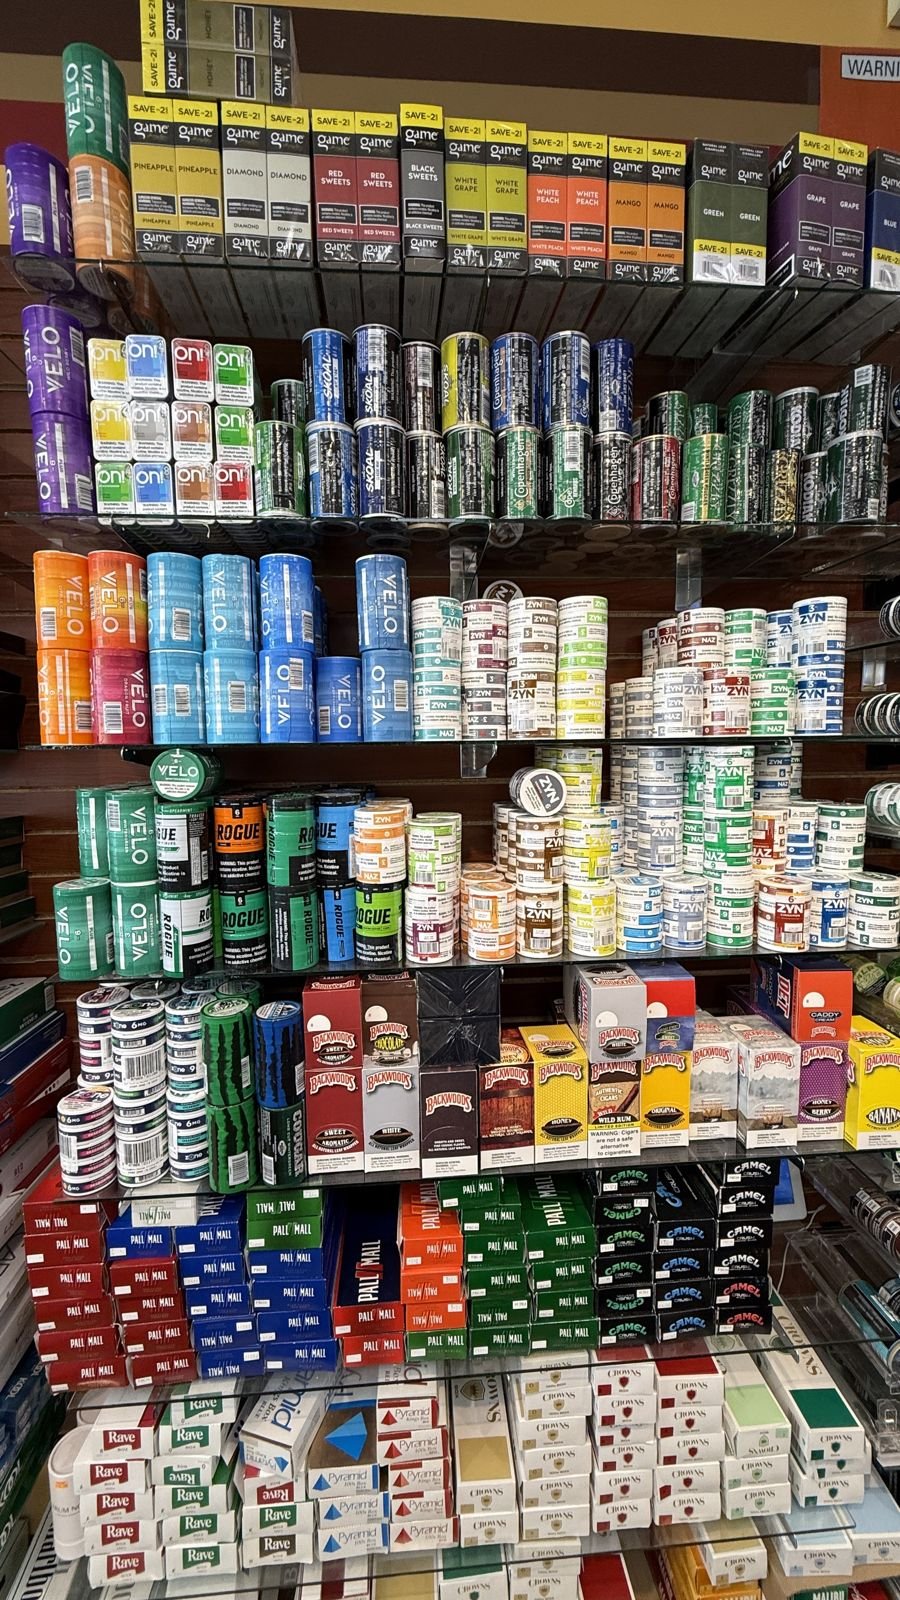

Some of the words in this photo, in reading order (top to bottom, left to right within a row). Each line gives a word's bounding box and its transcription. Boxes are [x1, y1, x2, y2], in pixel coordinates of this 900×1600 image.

[168, 51, 184, 88] game
[65, 63, 79, 136] VELO
[134, 122, 168, 138] game
[271, 131, 304, 147] game
[360, 138, 393, 153] game
[449, 142, 481, 158] game
[134, 163, 173, 172] PINEAPPLE
[411, 164, 434, 173] BLACK
[572, 156, 603, 172] game
[179, 166, 217, 175] PINEAPPLE
[227, 169, 263, 177] DIAMOND
[271, 172, 307, 180] DIAMOND
[701, 164, 727, 180] game
[837, 163, 864, 178] game
[321, 177, 351, 186] SWEETS
[409, 173, 438, 181] SWEETS
[496, 179, 518, 187] WHITE
[363, 180, 392, 188] SWEETS
[496, 187, 519, 195] GRAPE
[537, 188, 560, 196] WHITE
[537, 196, 559, 204] PEACH
[576, 198, 599, 206] PEACH
[807, 194, 826, 204] GRAPE
[840, 200, 859, 210] GRAPE
[654, 202, 679, 210] MANGO
[703, 208, 724, 216] GREEN
[739, 213, 760, 221] GREEN
[884, 219, 897, 228] BLUE
[42, 326, 61, 393] VELO
[323, 354, 332, 400] SKOAL
[494, 349, 504, 410] Copenhagen
[365, 376, 374, 413] SKOAL
[36, 434, 51, 500] VELO
[366, 449, 375, 492] SKOAL
[515, 437, 529, 498] Copenhagen
[608, 446, 623, 504] Copenhagen
[67, 576, 84, 635] VELO
[101, 571, 119, 633] VELO
[211, 571, 226, 632] VELO
[383, 574, 397, 633] VELO
[443, 618, 460, 628] ZYN
[800, 613, 825, 624] ZYN
[371, 666, 386, 726] VELO
[512, 689, 535, 700] ZYN
[727, 686, 749, 695] ZYN
[799, 689, 824, 698] ZYN
[131, 668, 146, 727] VELO
[717, 767, 743, 776] ZYN
[540, 775, 559, 805] ZYN
[130, 806, 148, 864] VELO
[217, 823, 259, 840] ROGUE
[652, 827, 674, 837] ZYN
[705, 852, 725, 862] ZYN
[680, 902, 703, 912] ZYN
[777, 904, 804, 913] ZYN
[824, 899, 846, 908] ZYN
[222, 908, 264, 927] ROGUE
[527, 909, 551, 919] ZYN
[304, 911, 313, 944] ROGUE
[334, 905, 343, 938] ROGUE
[57, 907, 70, 964] VELO
[130, 903, 147, 961] VELO
[163, 914, 171, 958] ROGUE
[370, 1023, 408, 1041] BACKWOODS
[599, 1028, 639, 1046] BACKWOODS
[375, 1037, 404, 1050] CHOCOLATE
[693, 1046, 731, 1063] BACKWOODS
[802, 1046, 842, 1065] BACKWOODS
[644, 1053, 685, 1072] BACKWOODS
[539, 1062, 582, 1083] BACKWOODS
[310, 1072, 355, 1094] BACKWOODS
[367, 1072, 412, 1094] BACKWOODS
[426, 1093, 472, 1115] BACKWOODS
[598, 1108, 613, 1116] WILD
[293, 1109, 304, 1177] COUGAR
[734, 1161, 771, 1175] CAMEL
[610, 1171, 648, 1183] CAMEL
[463, 1185, 475, 1194] PALL
[479, 1183, 493, 1192] MALL
[35, 1219, 50, 1228] MALL
[54, 1218, 68, 1227] PALL
[273, 1225, 289, 1236] PALL
[294, 1224, 311, 1235] MALL
[666, 1226, 705, 1239] CAMEL
[727, 1225, 764, 1239] CAMEL
[362, 1240, 380, 1266] MALL
[358, 1274, 379, 1302] PALL
[723, 1283, 760, 1297] CAMEL
[560, 1329, 572, 1337] PALL
[575, 1327, 589, 1336] MALL
[71, 1339, 85, 1348] PALL
[88, 1336, 103, 1345] MALL
[157, 1363, 171, 1372] PALL
[174, 1360, 189, 1368] MALL
[543, 1392, 576, 1400] CROWNS
[611, 1399, 644, 1407] CROWNS
[399, 1437, 438, 1449] Pyramid
[820, 1435, 852, 1443] CROWNS
[96, 1466, 122, 1477] Rave
[741, 1461, 772, 1471] CROWNS
[328, 1471, 367, 1485] Pyramid
[470, 1488, 503, 1496] CROWNS
[339, 1499, 378, 1511] Pyramid
[265, 1510, 291, 1521] Rave
[185, 1517, 212, 1528] Rave
[410, 1524, 448, 1537] Pyramid
[112, 1556, 139, 1568] Rave
